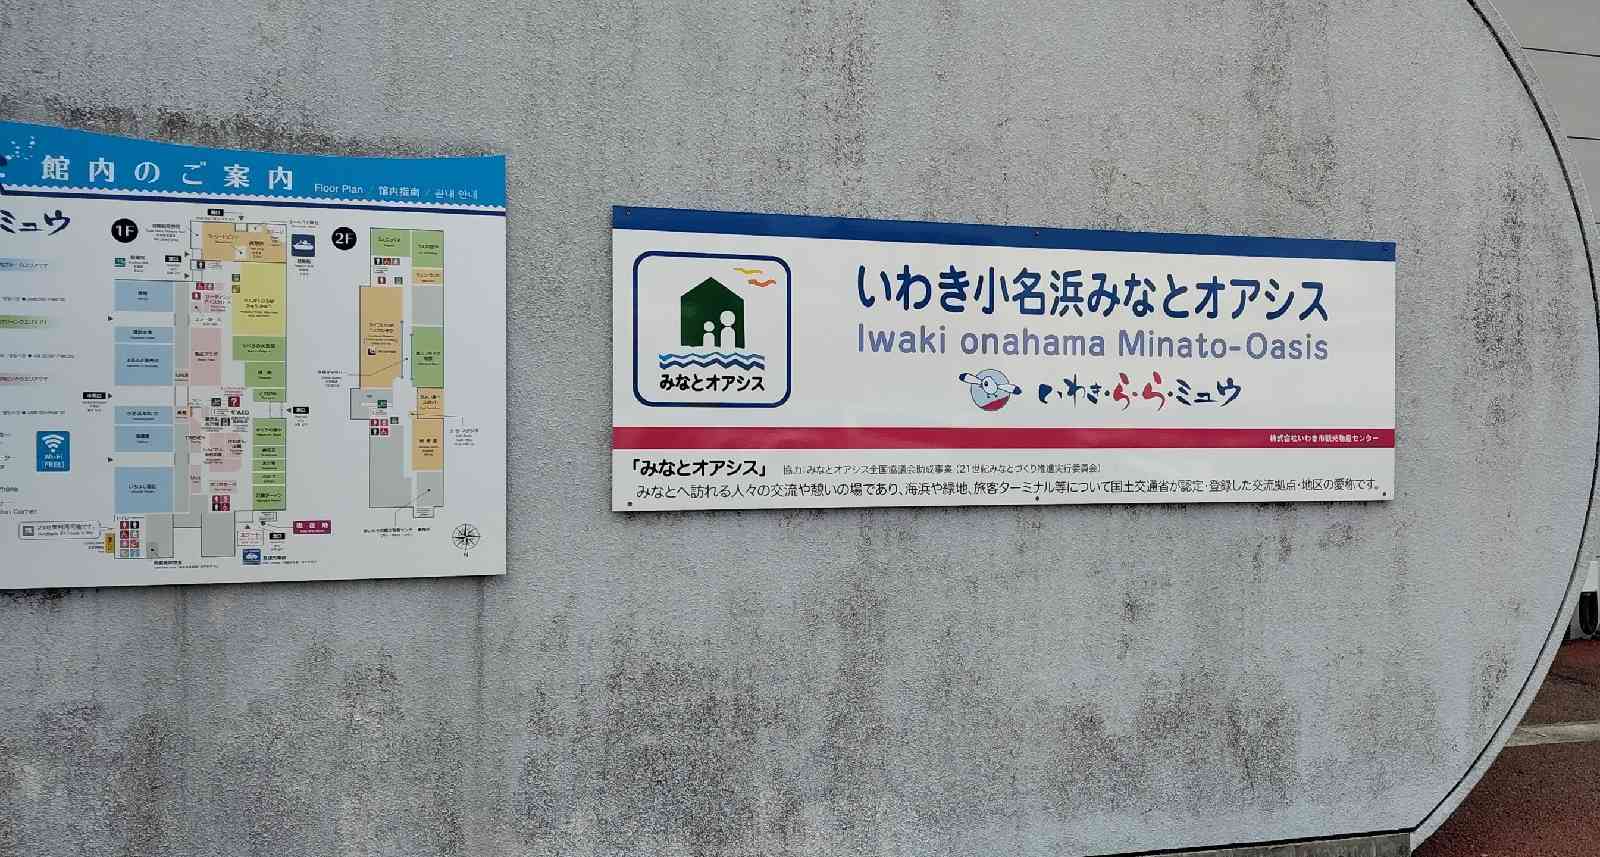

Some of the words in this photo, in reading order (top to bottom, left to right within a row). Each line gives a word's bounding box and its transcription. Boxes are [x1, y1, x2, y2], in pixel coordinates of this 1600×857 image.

[40, 155, 293, 191] 館内のご案内
[313, 183, 339, 194] Floor
[342, 184, 364, 195] Plan
[116, 225, 135, 236] 1F
[335, 232, 352, 243] 2F
[857, 264, 1329, 322] いわき小名浜みなとオアシス
[858, 323, 946, 354] Iwaki
[960, 328, 1105, 357] onahama
[1118, 329, 1328, 361] Minato-Oasis
[659, 373, 765, 392] みなとオアシス
[632, 458, 767, 477] 「みなとオアシス」
